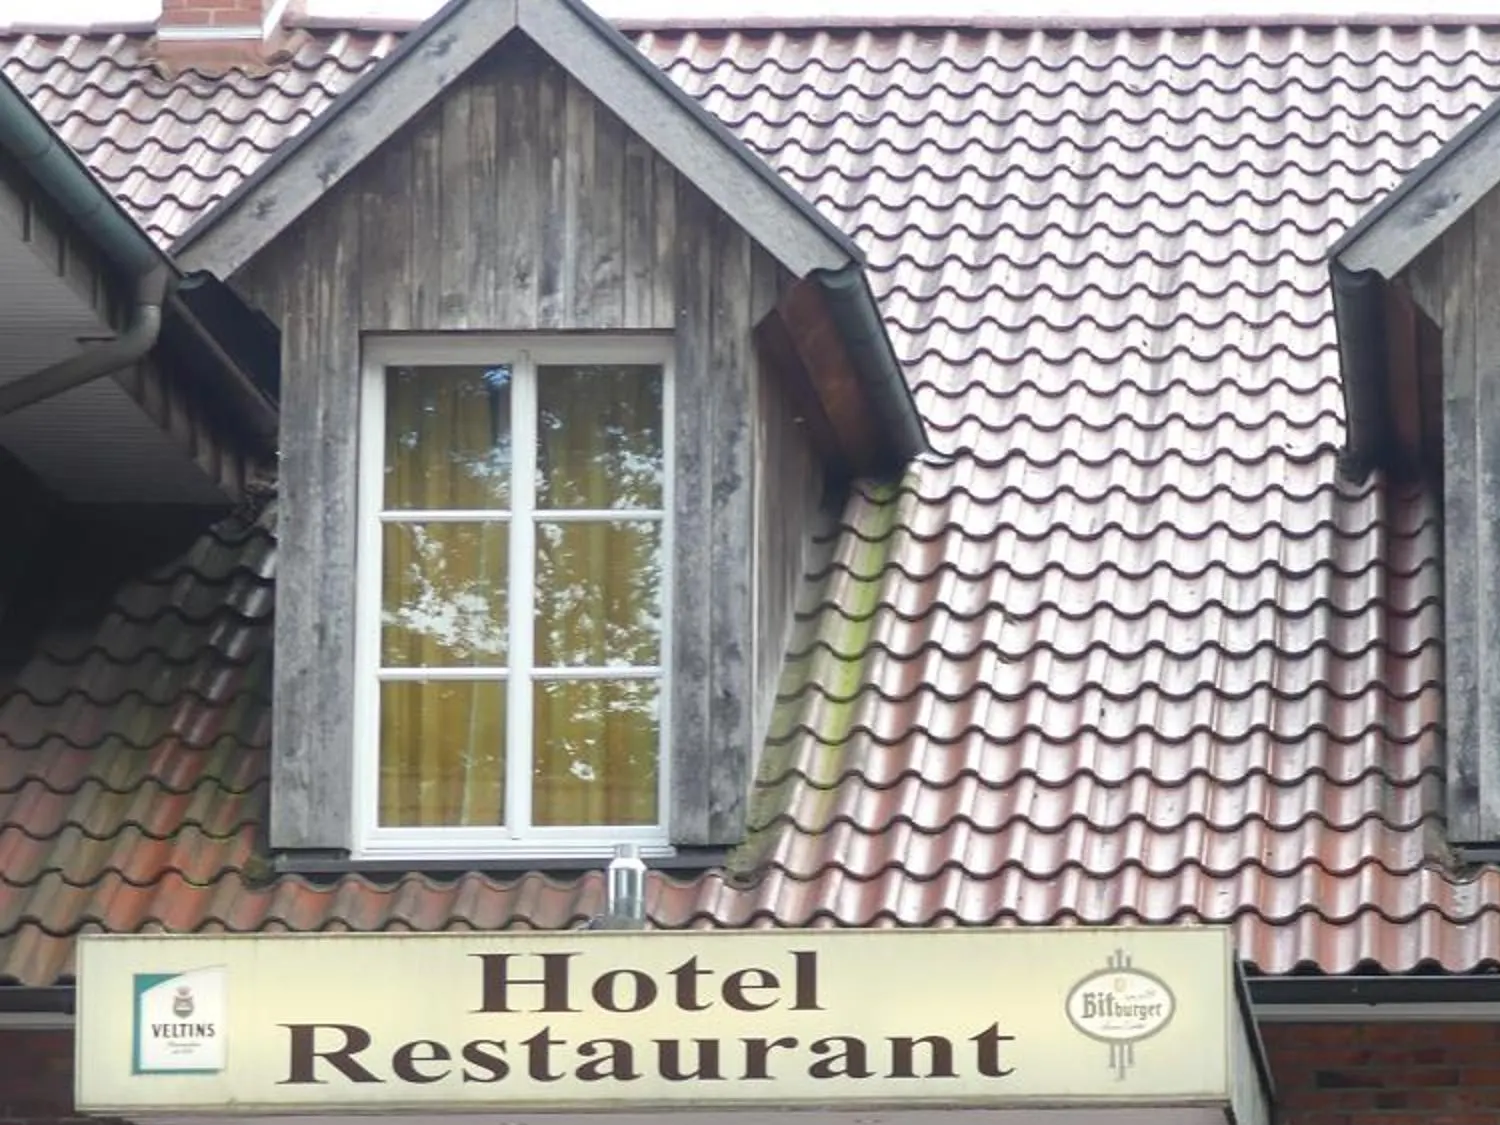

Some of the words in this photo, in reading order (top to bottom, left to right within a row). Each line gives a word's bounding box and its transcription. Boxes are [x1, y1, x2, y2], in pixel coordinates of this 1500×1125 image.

[467, 950, 826, 1014] Hotel
[1080, 991, 1162, 1020] Bitburger
[151, 1023, 215, 1038] VELTINS
[275, 1021, 1016, 1085] Restaurant
